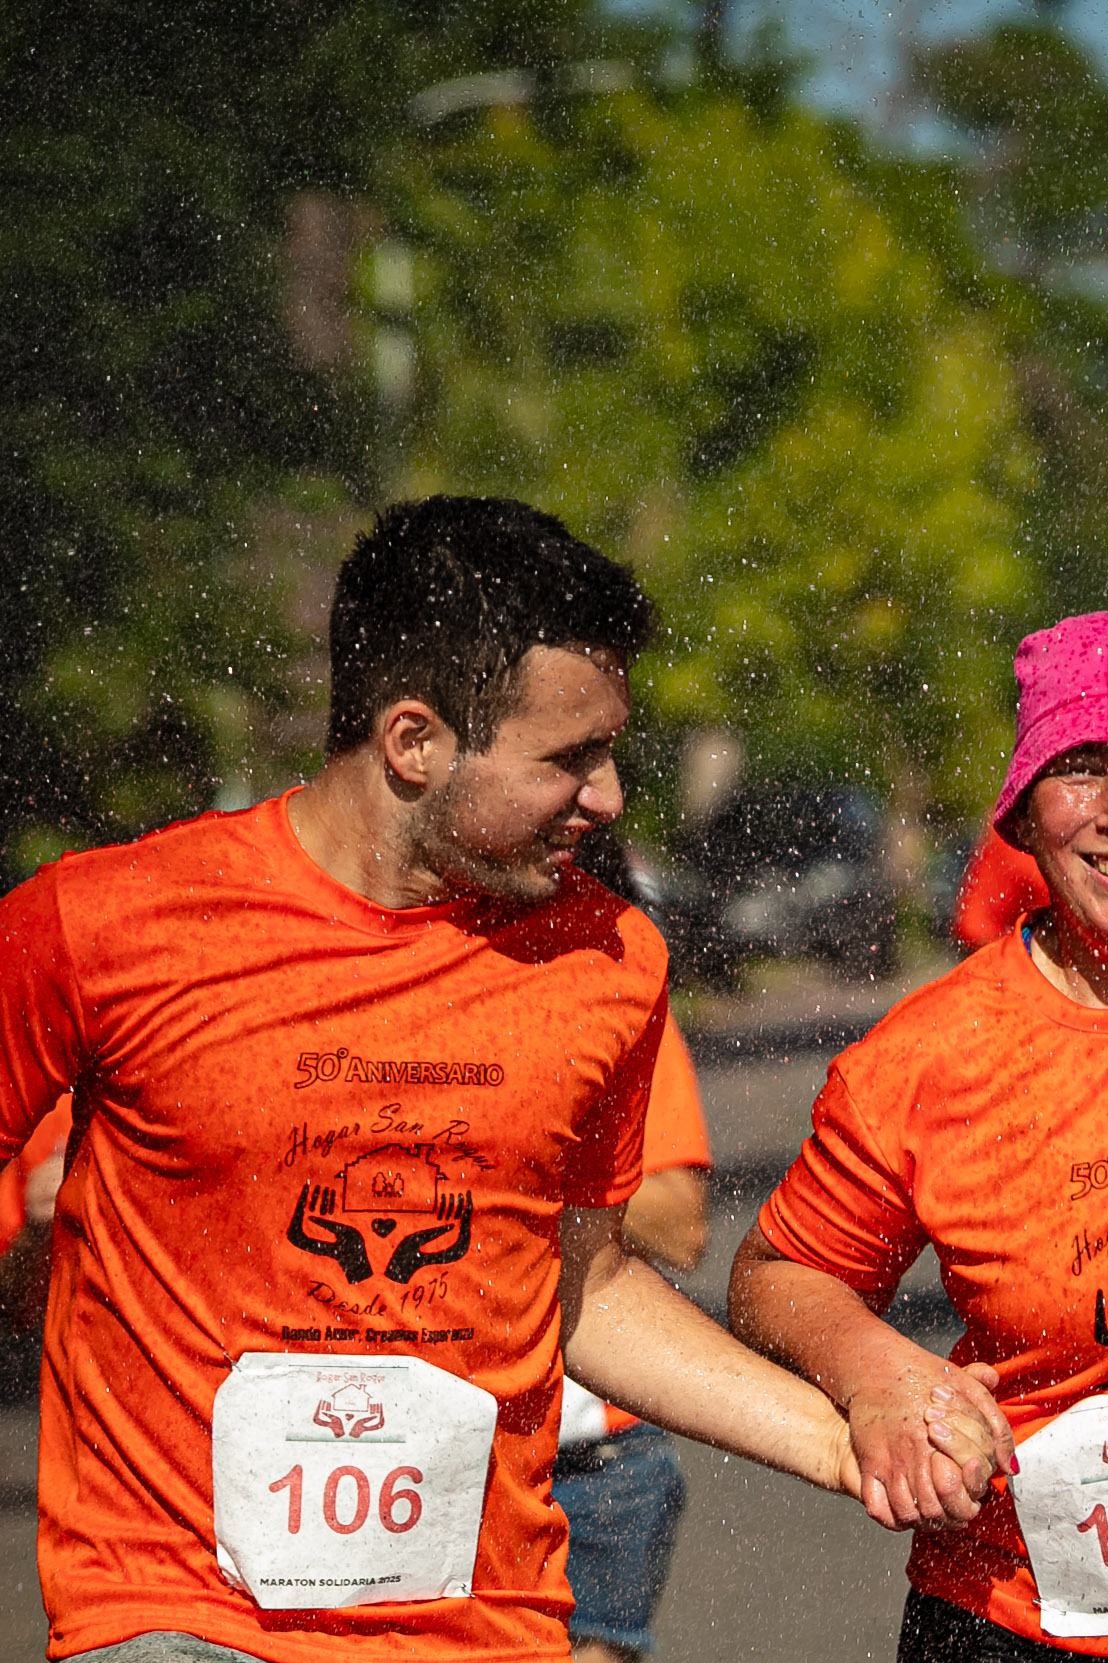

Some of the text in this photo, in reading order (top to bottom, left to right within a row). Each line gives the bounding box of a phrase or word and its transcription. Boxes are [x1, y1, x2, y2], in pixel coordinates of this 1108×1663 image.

[345, 1056, 505, 1087] ANIVERSARIO
[284, 1102, 495, 1172] Hogar San Roque
[307, 1270, 449, 1317] Desde 1975
[281, 1325, 322, 1342] Dando
[268, 1463, 424, 1535] 106
[259, 1578, 316, 1587] MARATON
[318, 1577, 376, 1587] SOLIDARIA
